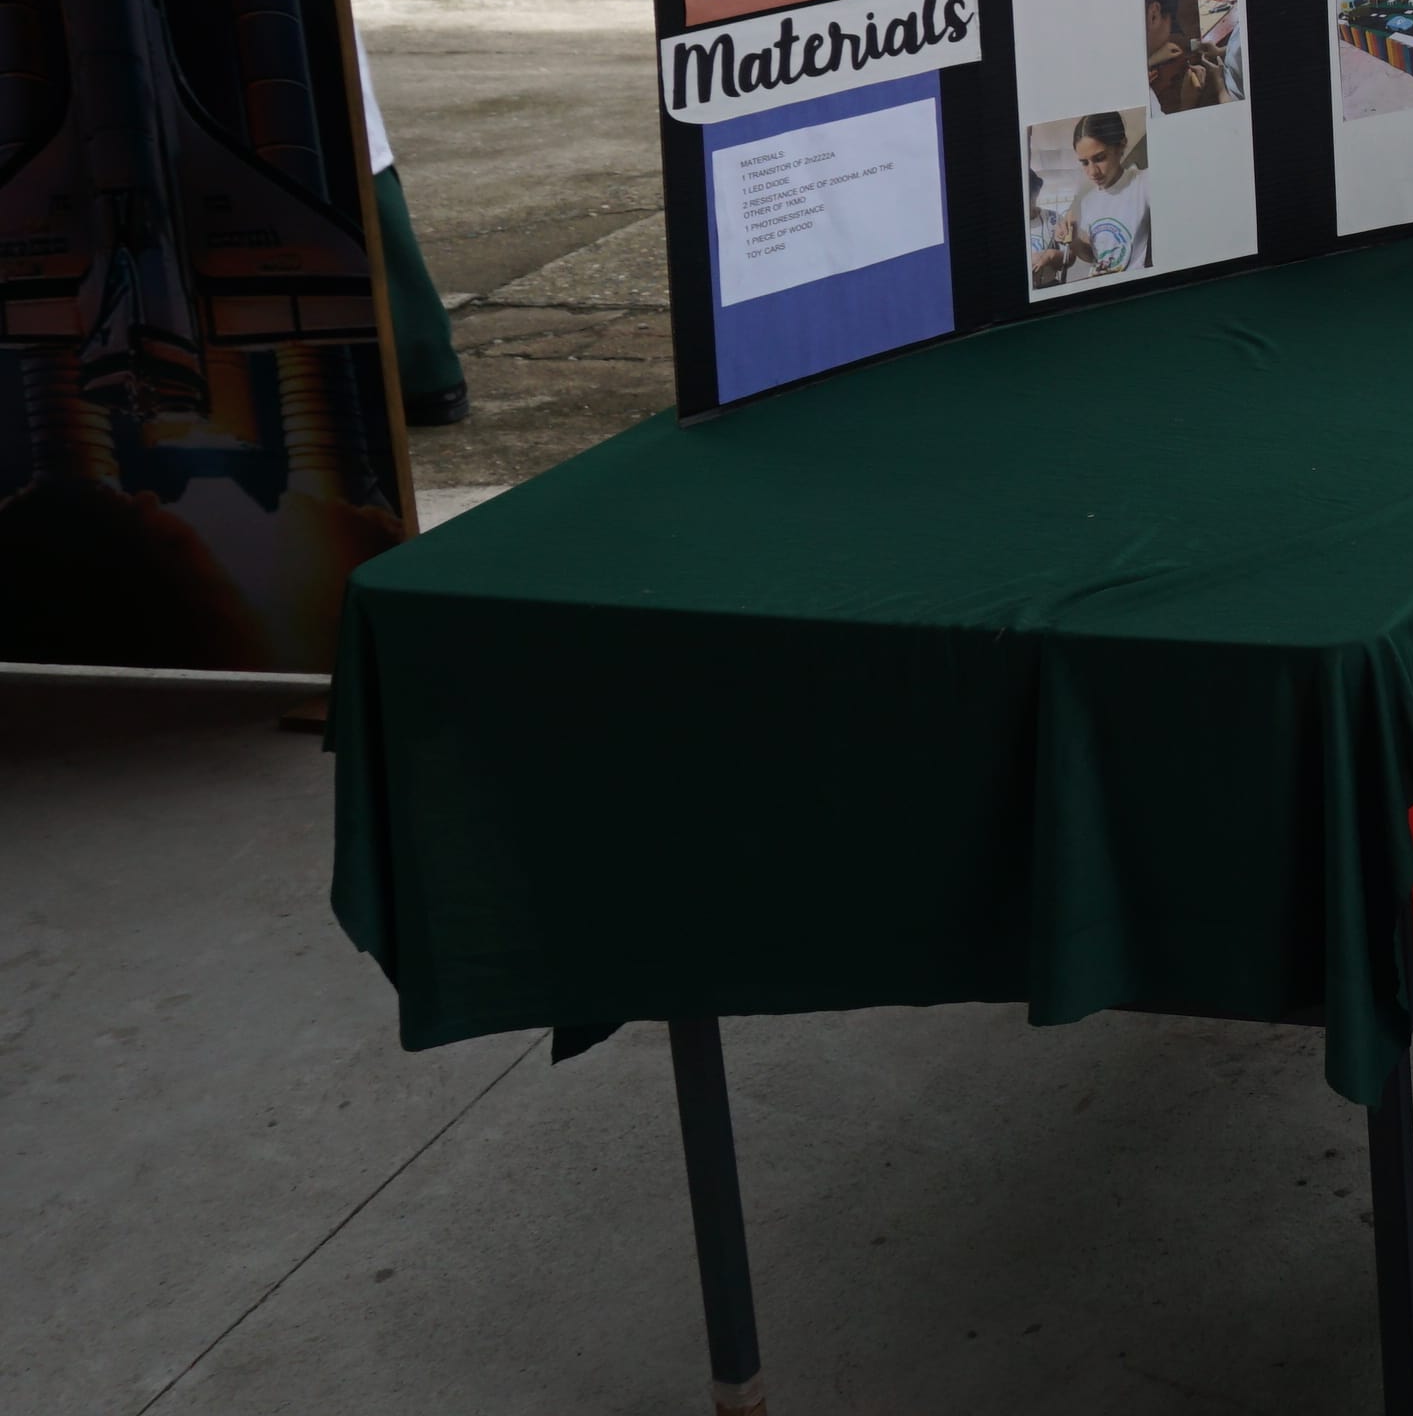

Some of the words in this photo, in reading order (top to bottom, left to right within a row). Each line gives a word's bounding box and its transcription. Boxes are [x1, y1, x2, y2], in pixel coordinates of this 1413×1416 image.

[793, 159, 803, 168] OF
[748, 183, 764, 194] LED
[766, 177, 790, 189] DIODE
[750, 189, 798, 207] RESISTANCE
[800, 184, 815, 193] ONE
[817, 180, 830, 188] OF
[862, 167, 877, 176] AND
[878, 162, 894, 172] THE
[744, 205, 771, 219] OTHER
[773, 202, 784, 212] OF
[750, 204, 825, 231] PHOTORESISTANCE
[777, 228, 788, 236] OF
[789, 221, 813, 234] WOOD
[746, 249, 762, 259] TOY
[764, 243, 786, 255] CARS
